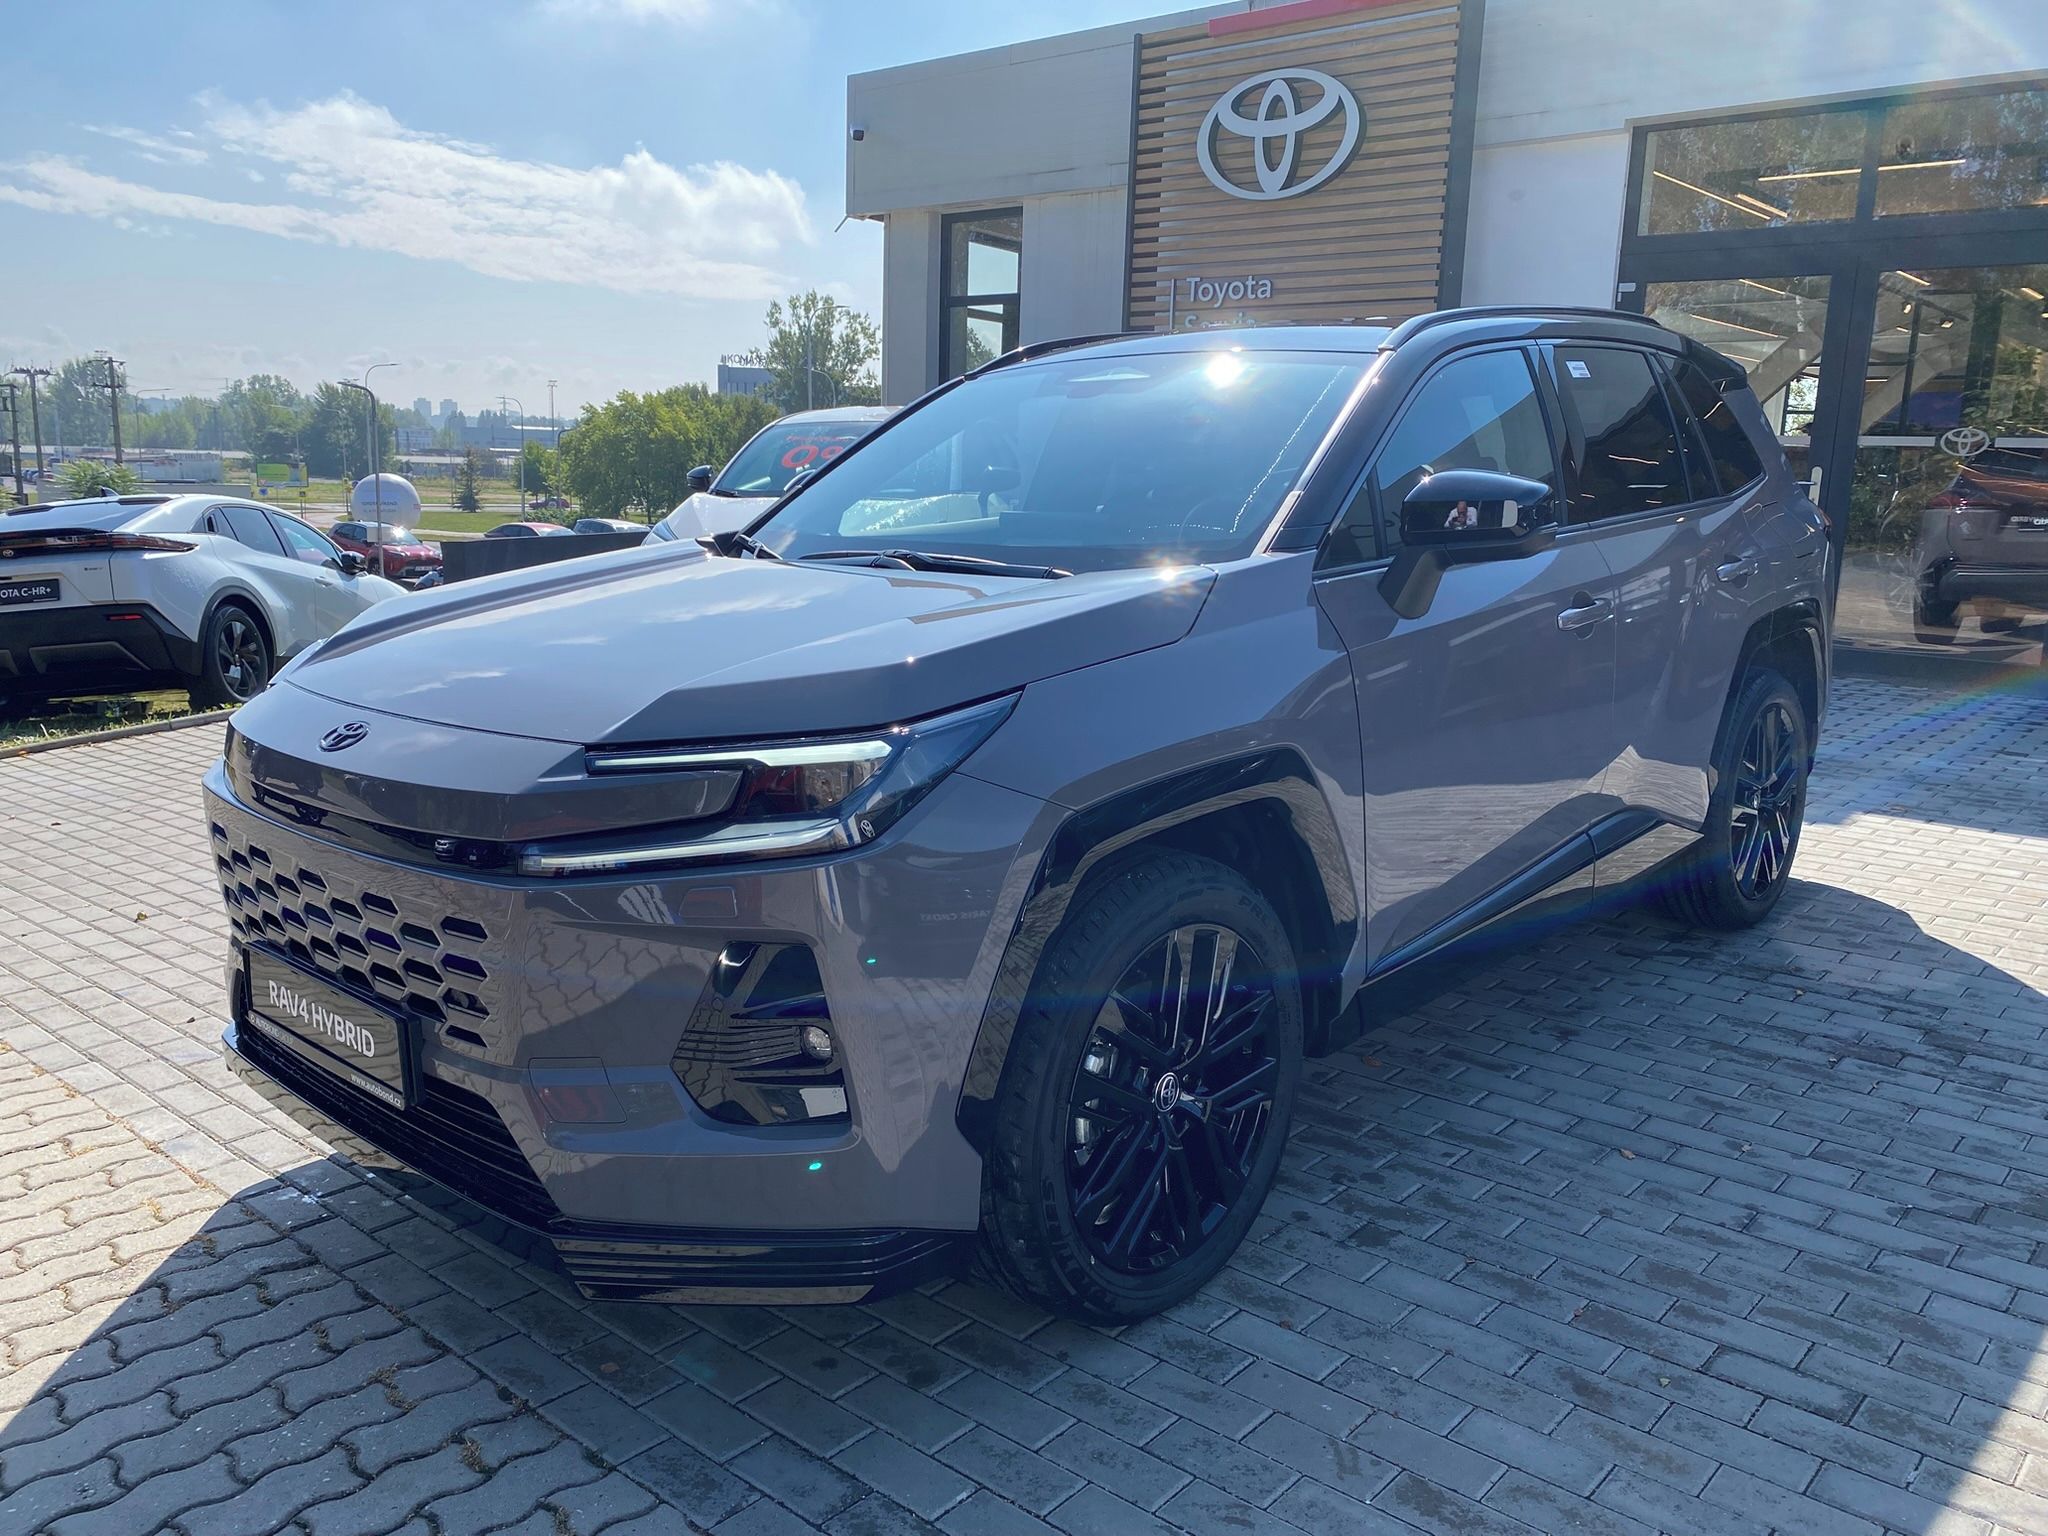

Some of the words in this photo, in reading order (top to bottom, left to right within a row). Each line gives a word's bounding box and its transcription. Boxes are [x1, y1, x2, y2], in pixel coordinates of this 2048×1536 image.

[1186, 275, 1272, 308] Toyota
[21, 586, 52, 597] C-HR+
[268, 980, 309, 1023] RAV4
[312, 1002, 375, 1058] HYBRID
